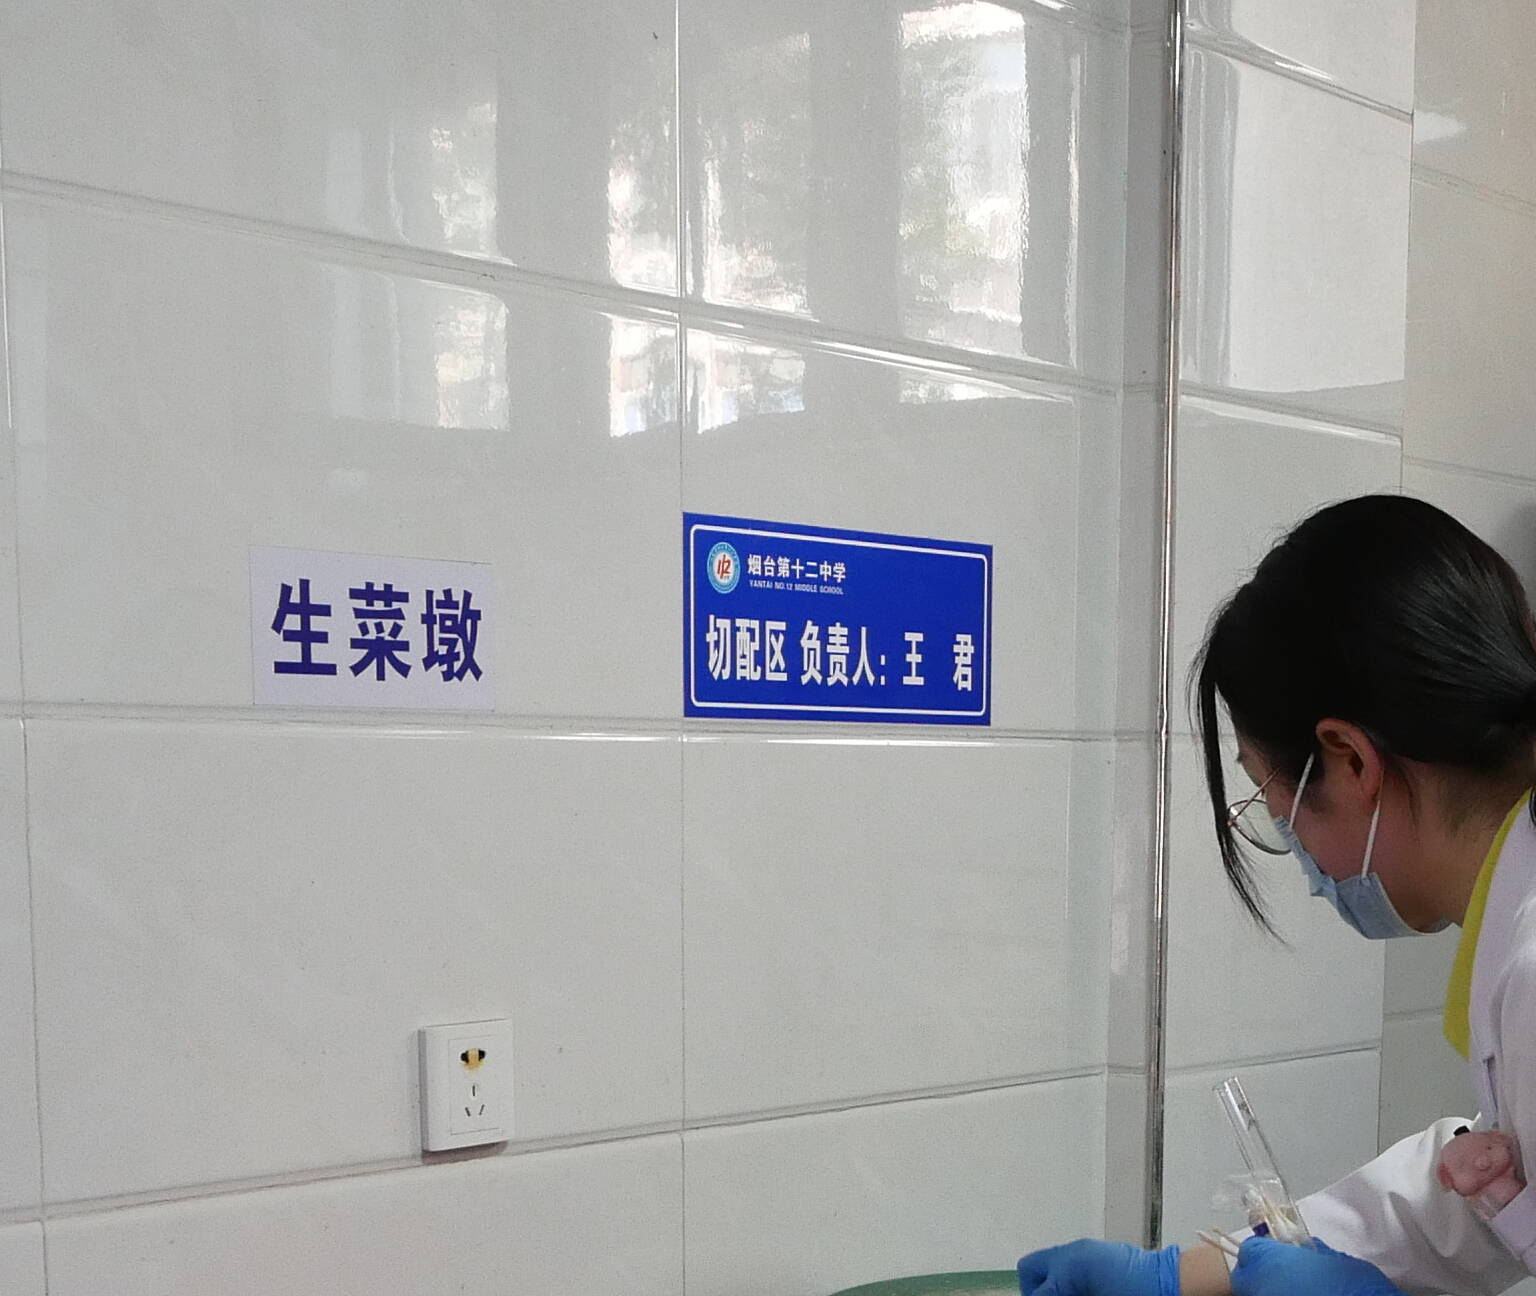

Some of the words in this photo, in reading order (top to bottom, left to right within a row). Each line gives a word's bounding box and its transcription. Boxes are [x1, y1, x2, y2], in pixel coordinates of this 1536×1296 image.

[747, 554, 846, 583] 烟台第十二中学
[749, 579, 773, 589] YANTAI
[795, 583, 818, 593] MIDDLE
[819, 585, 844, 595] SCHOOL
[271, 578, 483, 682] 生菜墩
[705, 614, 788, 682] 切配区
[902, 632, 925, 686] 王
[953, 634, 975, 692] 君
